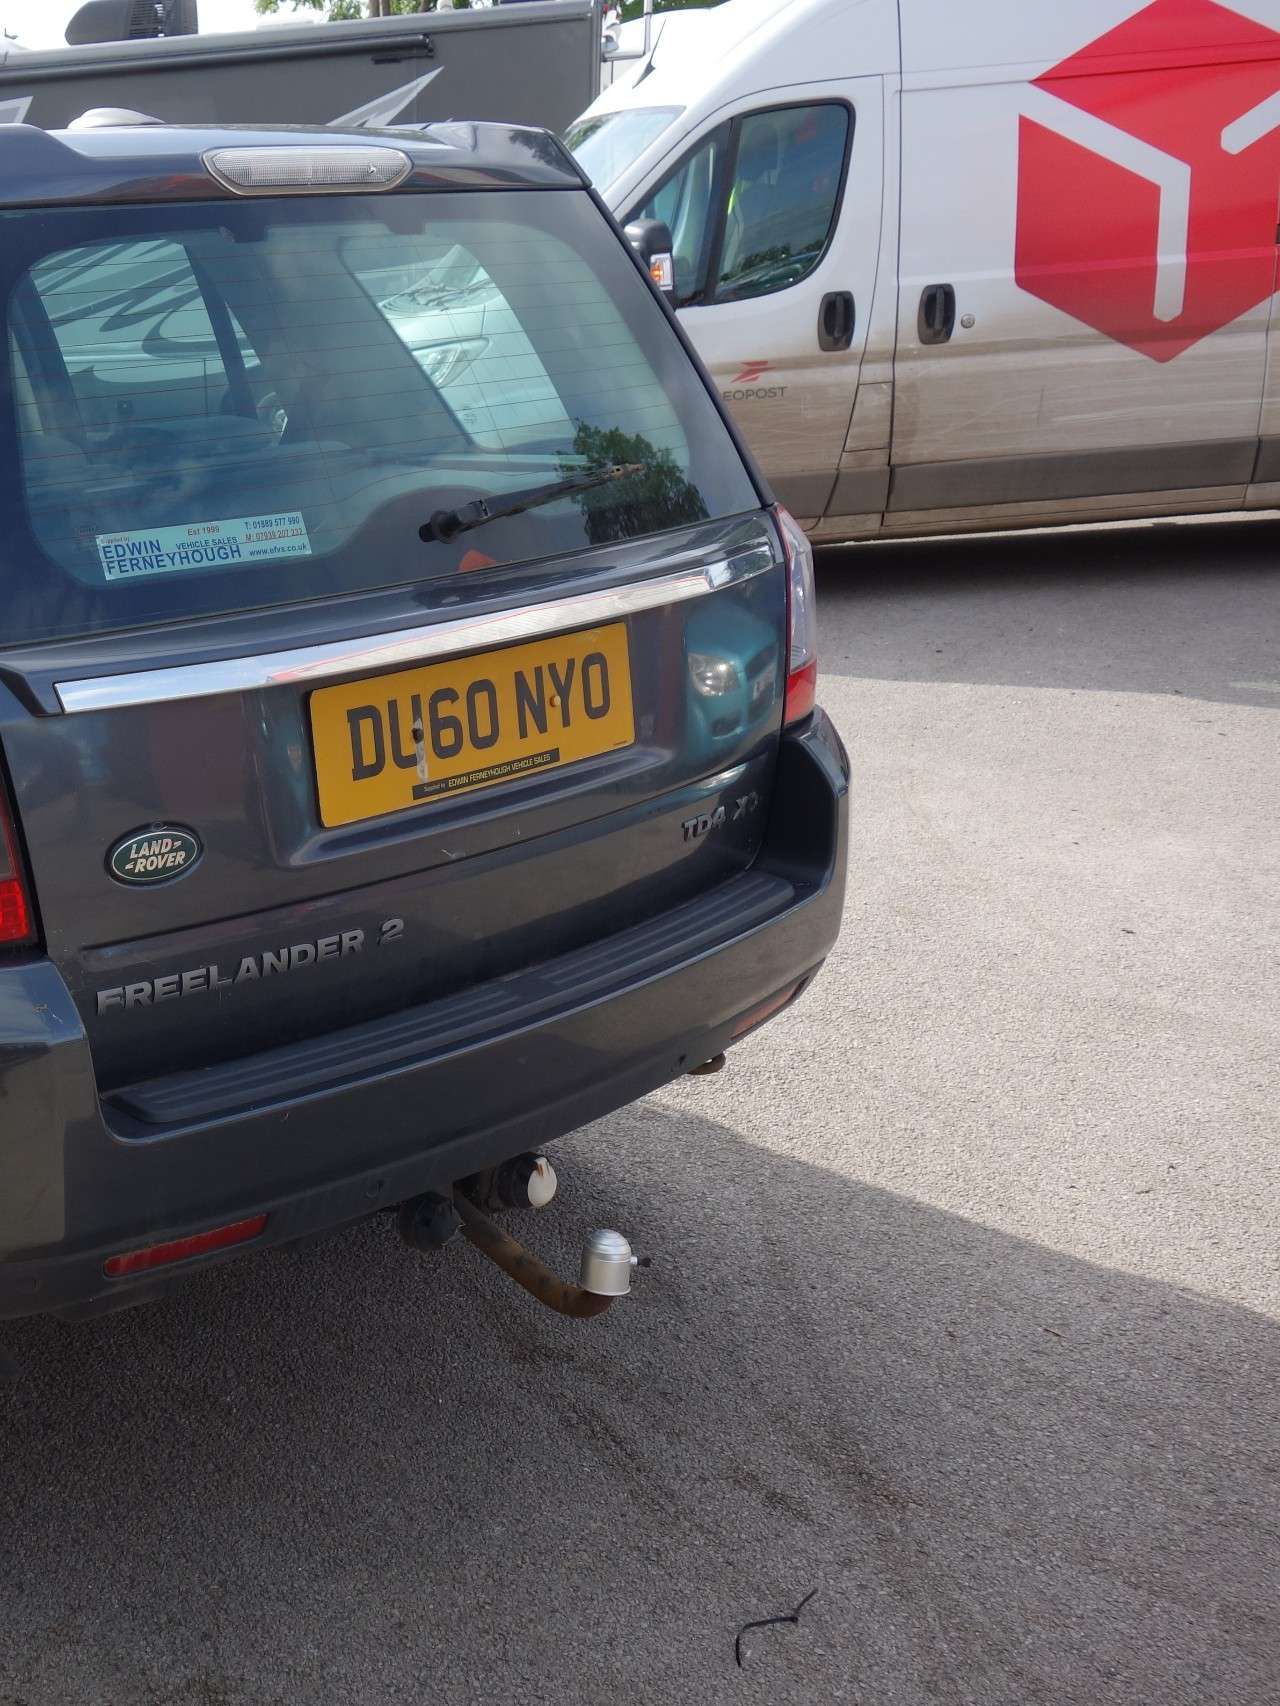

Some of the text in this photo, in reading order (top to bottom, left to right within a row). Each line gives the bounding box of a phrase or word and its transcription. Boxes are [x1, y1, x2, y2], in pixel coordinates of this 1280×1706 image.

[722, 385, 789, 401] EOPOST
[187, 528, 201, 536] Est
[253, 519, 273, 529] 01889
[274, 517, 287, 526] 577
[102, 539, 162, 560] EDWIN
[176, 536, 238, 550] VEHICLE SALES
[106, 545, 241, 574] FERNEYHOUGH
[346, 651, 611, 781] DU60 NYO
[448, 775, 470, 788] EDWIN
[469, 764, 511, 781] FERNEYHOUGH
[511, 758, 534, 771] VEHICLE
[533, 754, 551, 763] SALES
[129, 838, 170, 860] LAND
[134, 850, 187, 873] ROVER
[96, 917, 406, 1016] FREELANDER 2
